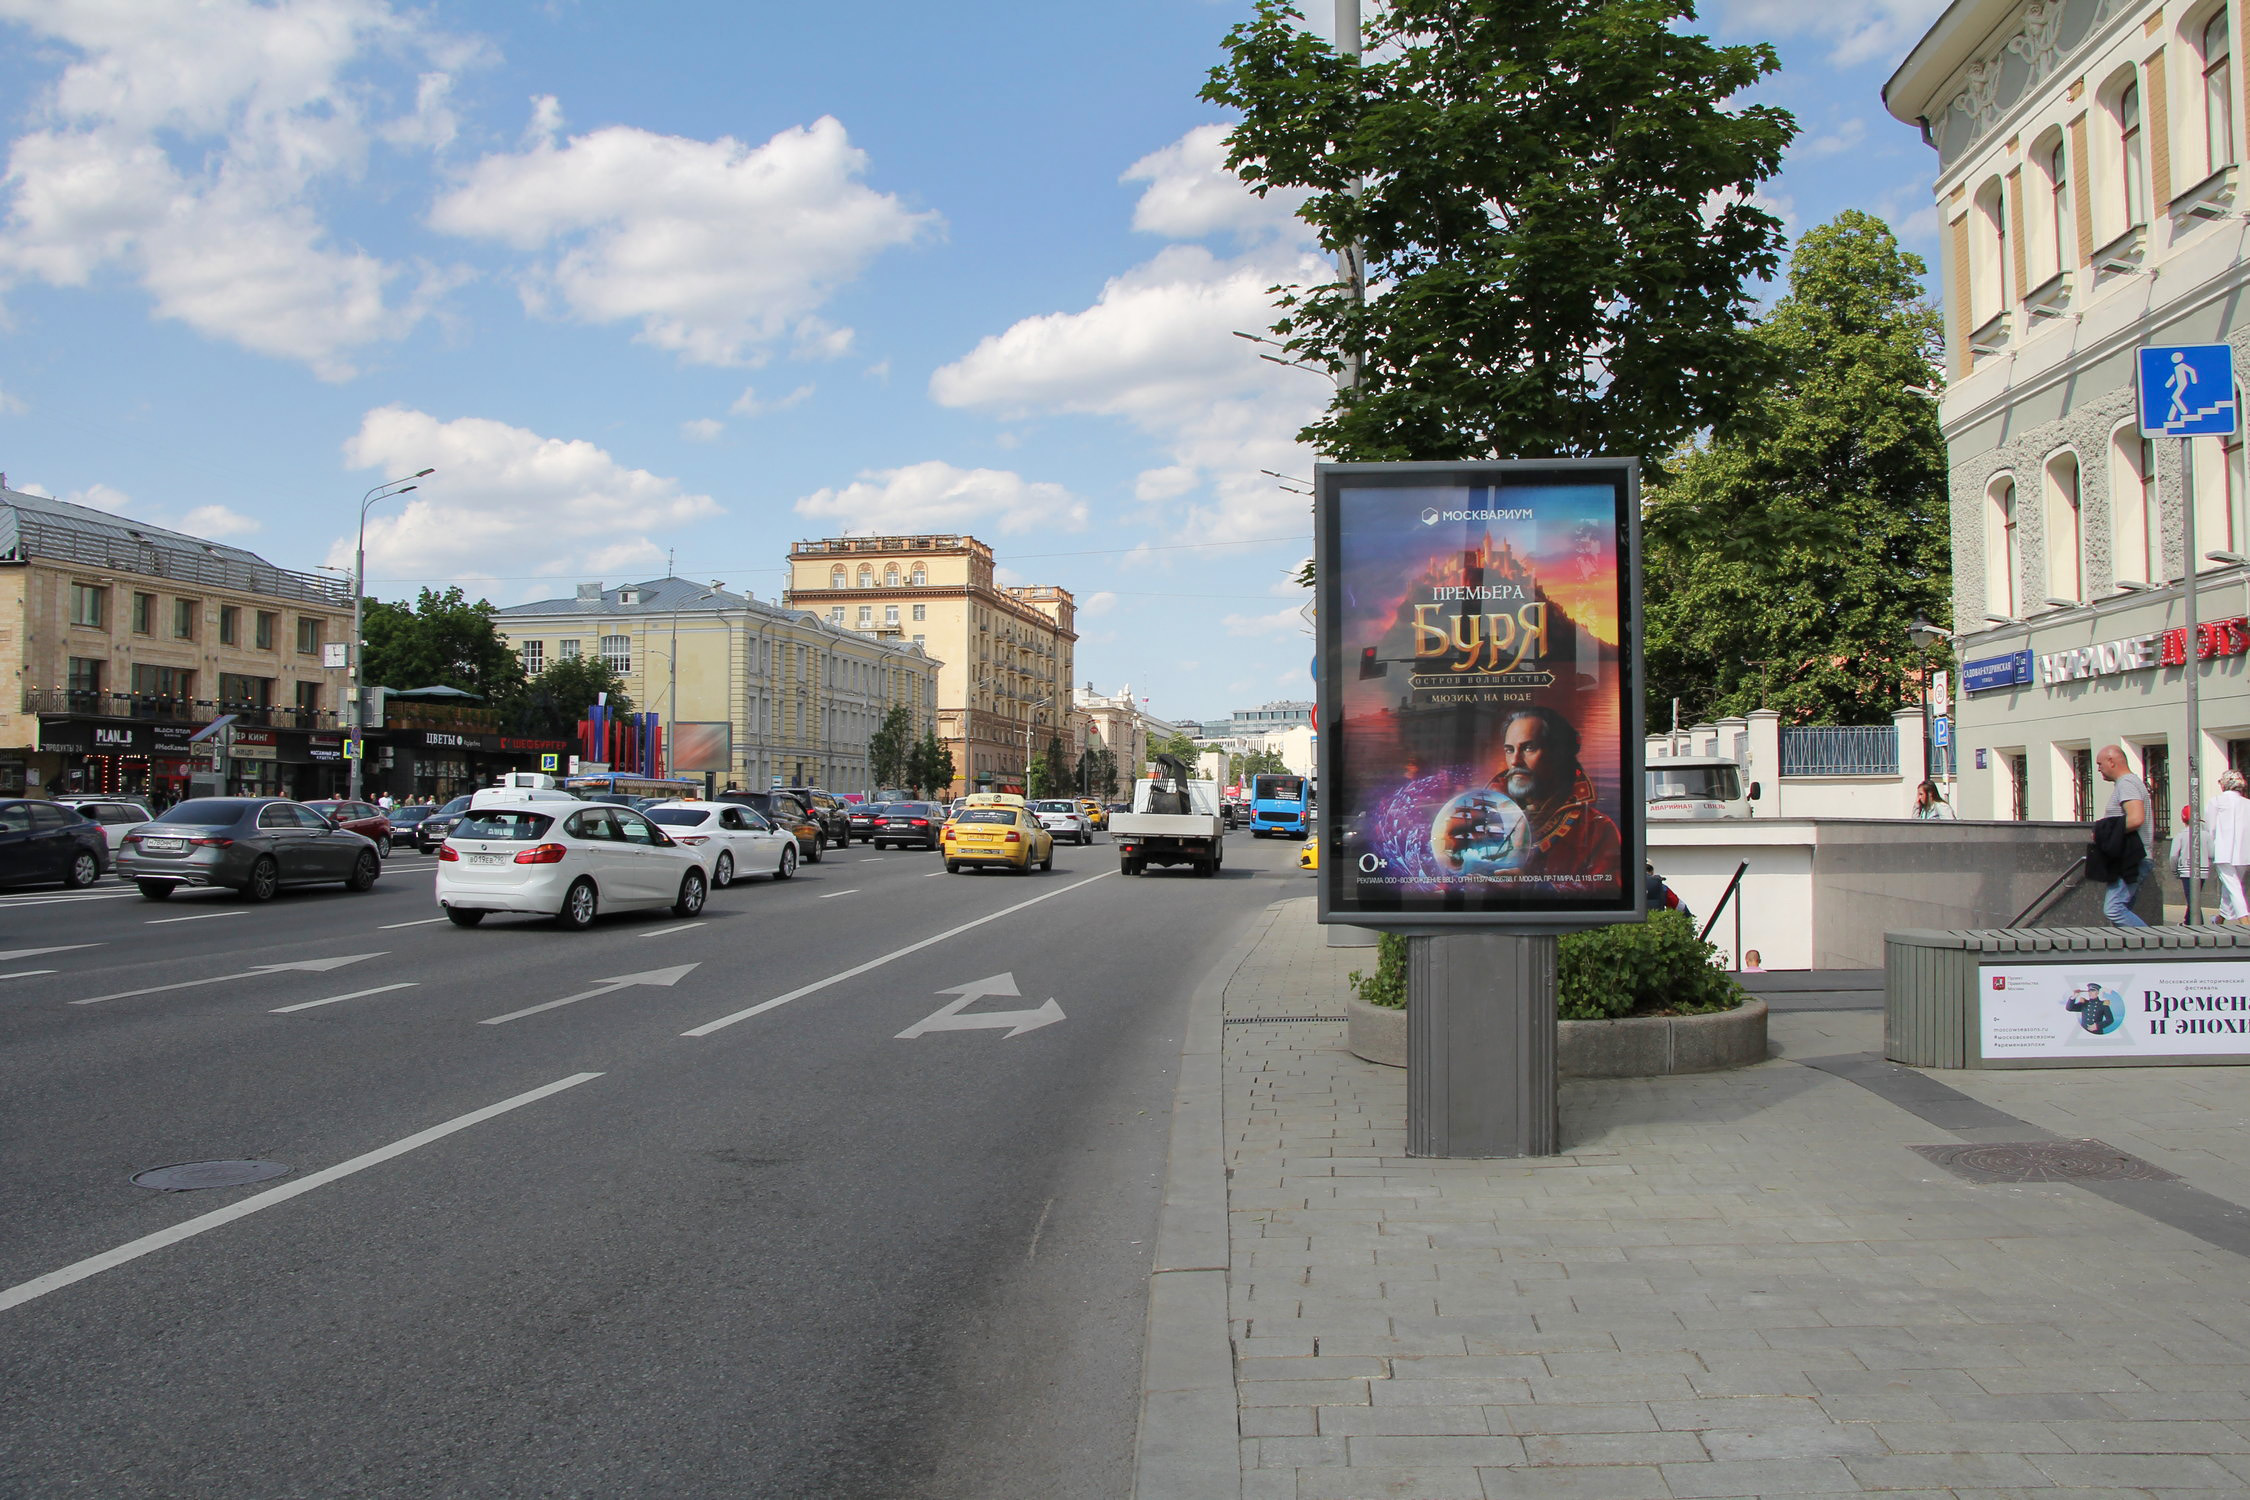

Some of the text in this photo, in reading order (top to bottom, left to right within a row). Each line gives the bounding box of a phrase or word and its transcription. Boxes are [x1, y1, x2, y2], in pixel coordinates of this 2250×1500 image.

[1442, 508, 1533, 521] МОСКВАРИУМ
[1432, 585, 1525, 601] ПРЕМЬЕРА
[1467, 675, 1548, 684] ВОЛШЕБСТВА
[1431, 692, 1532, 704] МЮЗИКЛ НА ВОДЕ
[248, 731, 269, 742] КИНГ
[426, 732, 456, 746] ЦВЕТЫ
[1650, 803, 1693, 811] АВАРИЙНАЯ
[1384, 876, 1397, 885] ООО
[2144, 991, 2250, 1018] Времен
[2150, 1020, 2166, 1034] и
